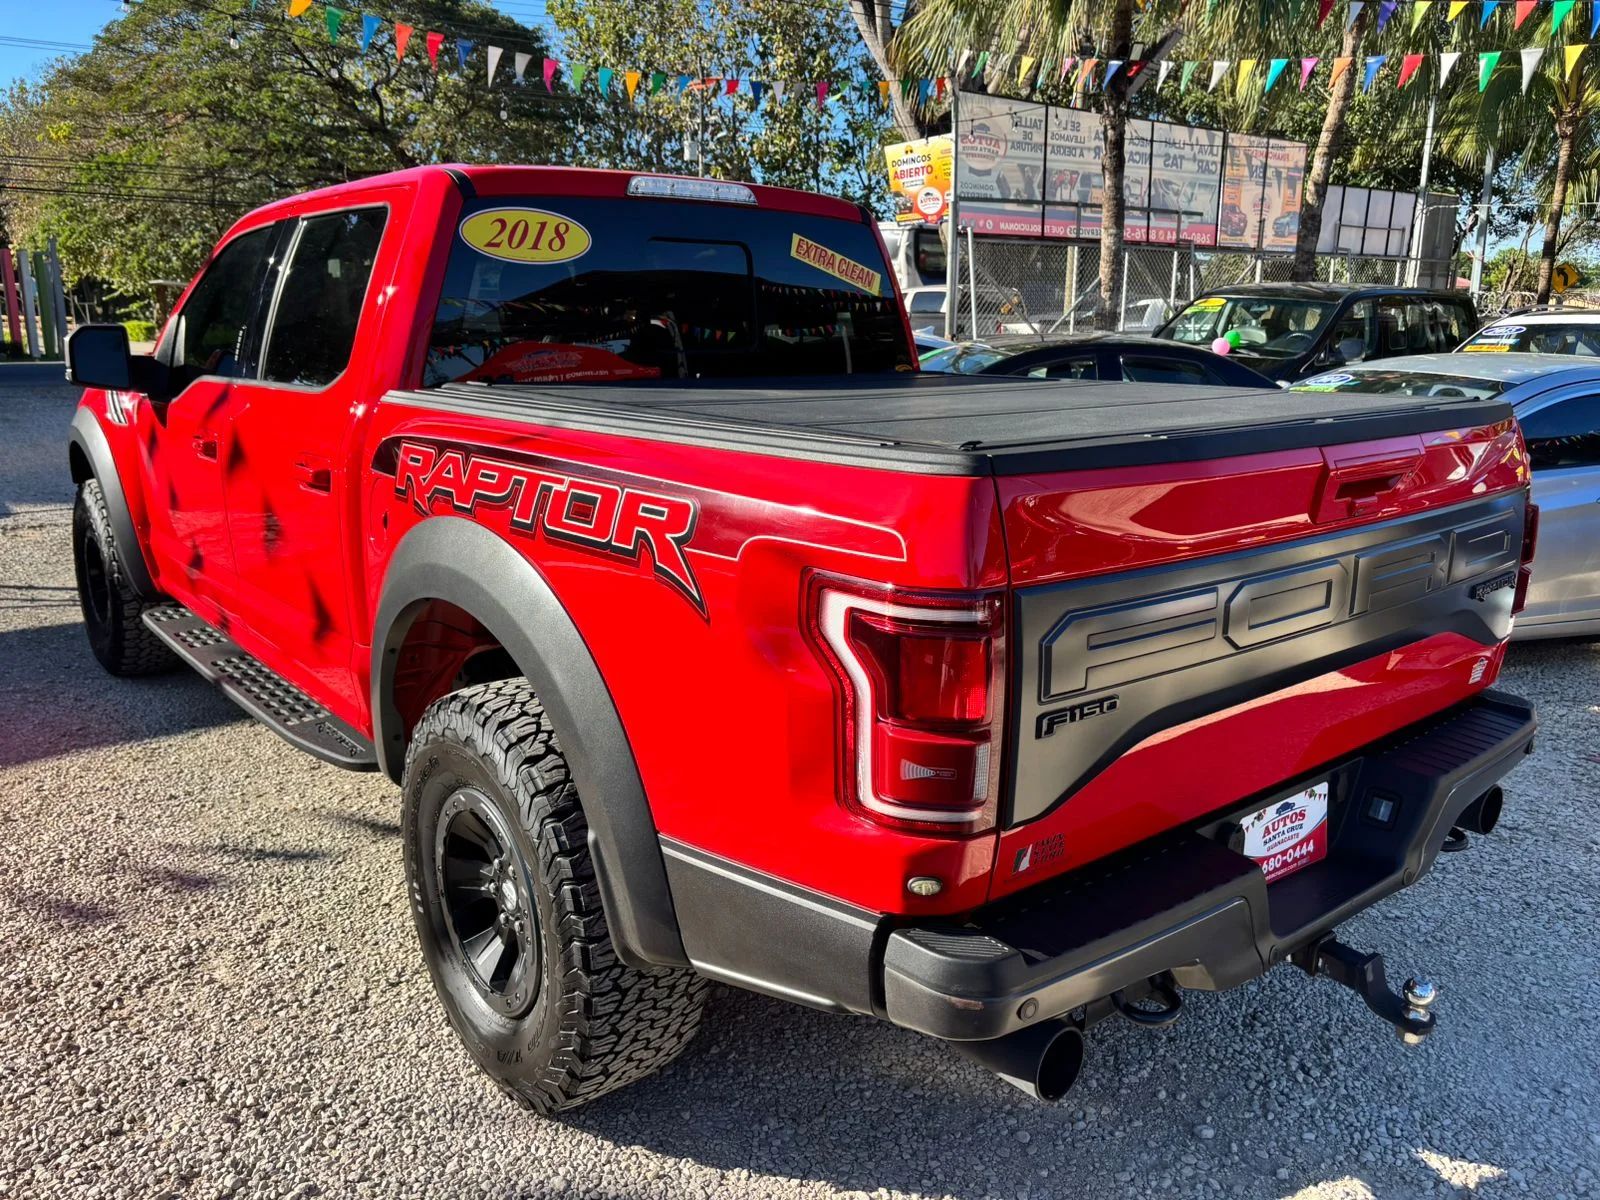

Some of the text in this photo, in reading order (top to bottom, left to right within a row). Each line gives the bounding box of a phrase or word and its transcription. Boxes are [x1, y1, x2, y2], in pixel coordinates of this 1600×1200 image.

[891, 153, 932, 168] DOMINGOS
[893, 164, 934, 181] ABIERTO
[483, 217, 570, 252] 2018
[796, 238, 877, 289] EXTRA CLEAN
[394, 441, 709, 622] RAPTOR
[1038, 504, 1518, 704] FORD
[1262, 809, 1306, 839] AUTOS
[1263, 823, 1304, 846] SANTA CRUZ
[1261, 839, 1315, 875] 680-0444
[1266, 832, 1300, 852] GUANACASTE
